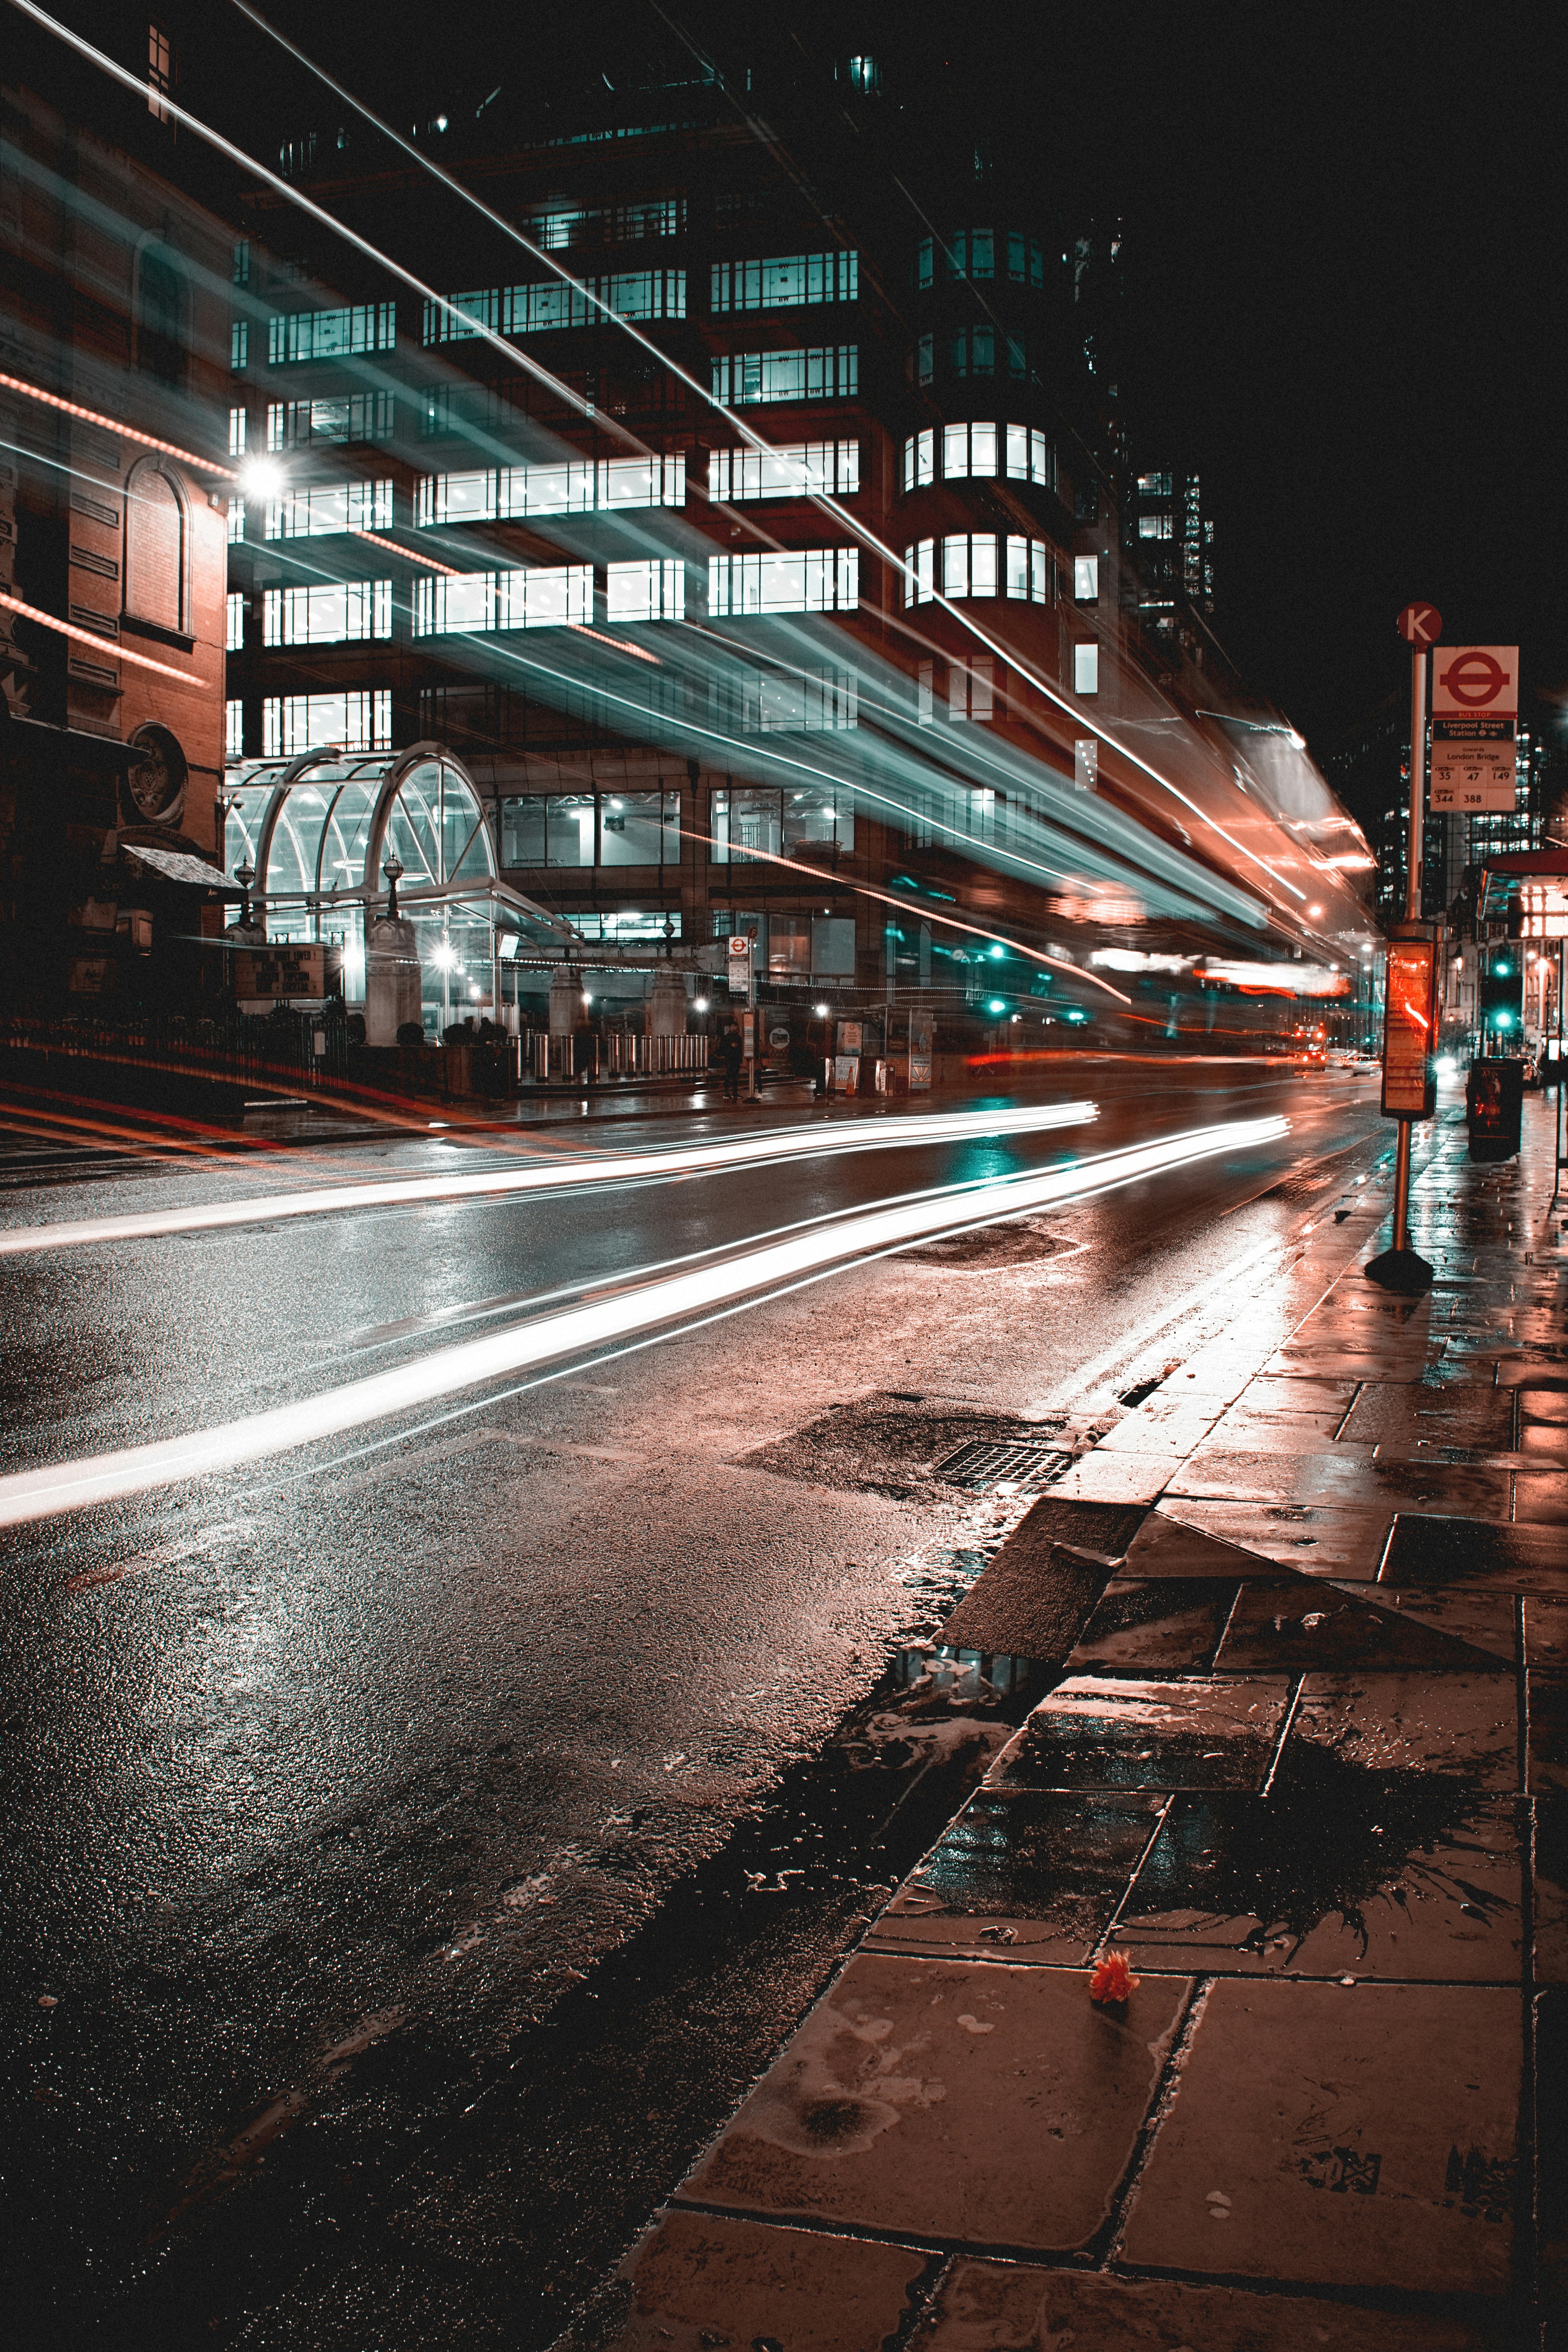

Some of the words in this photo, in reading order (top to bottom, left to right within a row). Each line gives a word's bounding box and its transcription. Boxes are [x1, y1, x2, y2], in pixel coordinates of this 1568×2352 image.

[1407, 608, 1432, 641] K
[751, 928, 757, 937] F
[294, 951, 311, 960] LOVED
